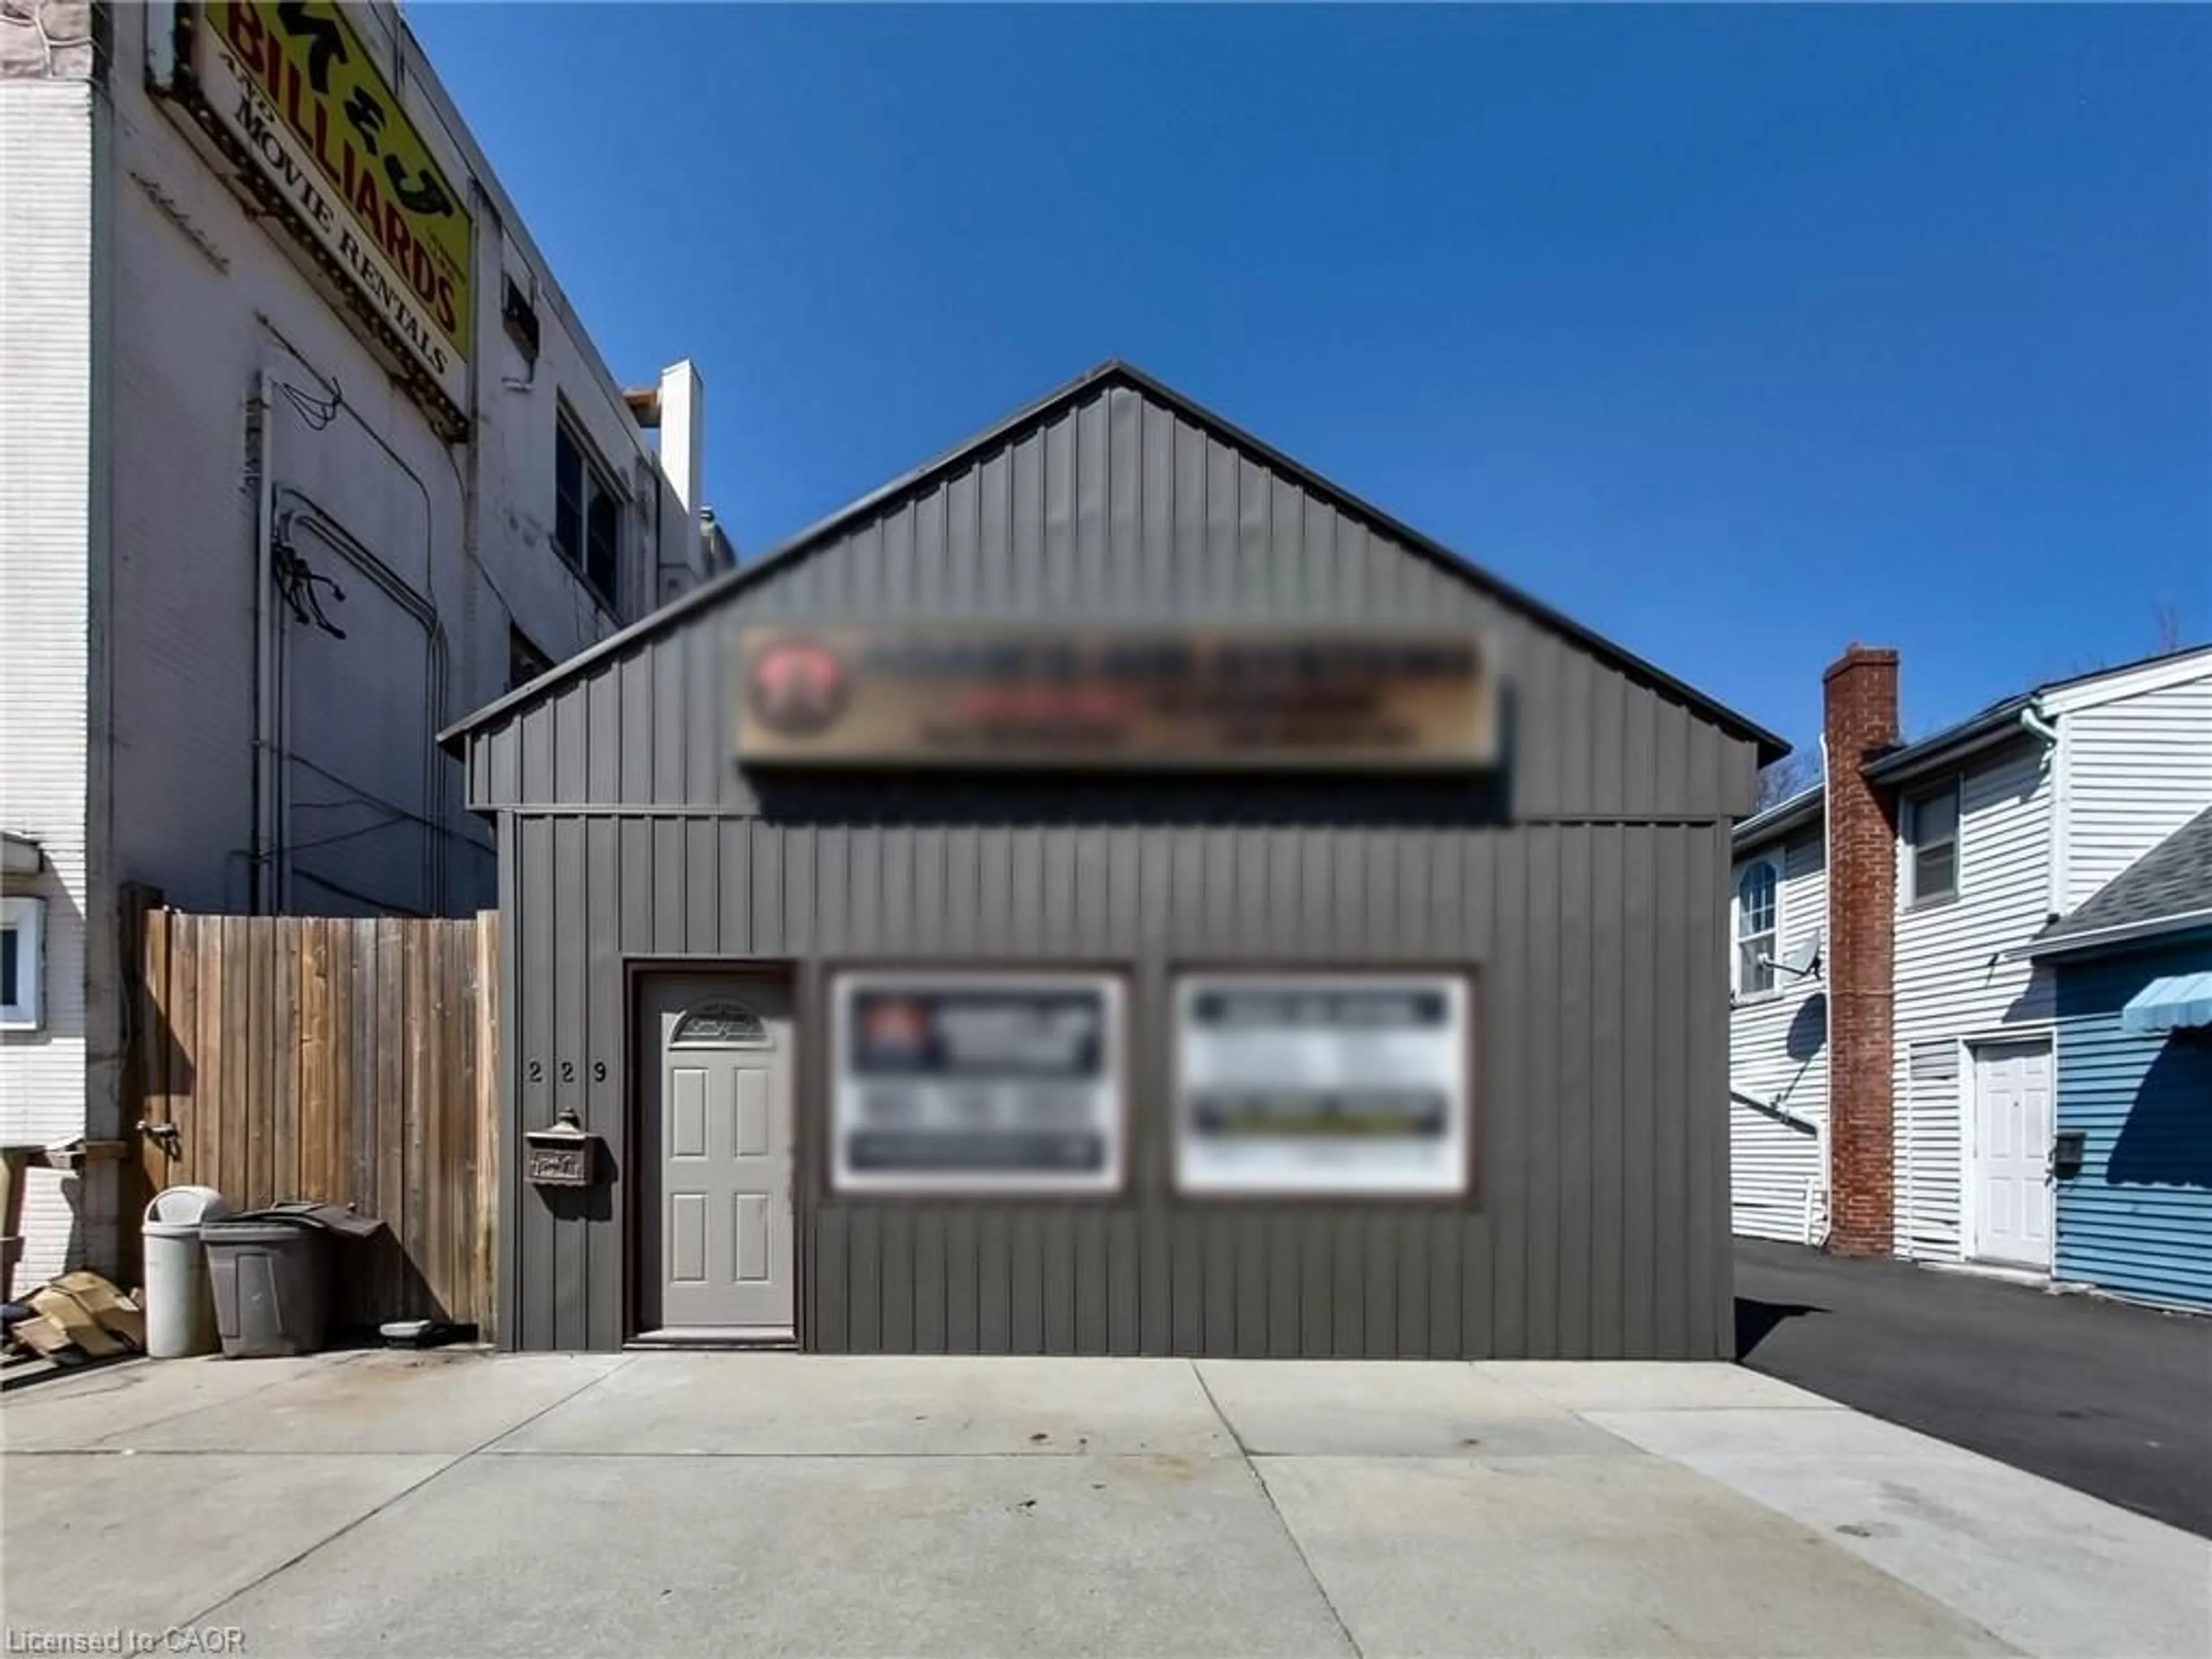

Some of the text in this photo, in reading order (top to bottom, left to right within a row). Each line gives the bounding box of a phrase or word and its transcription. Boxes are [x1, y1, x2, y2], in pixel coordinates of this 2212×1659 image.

[228, 0, 456, 334] BILLIARDS
[234, 94, 334, 233] MOVIE
[338, 225, 448, 375] RENTALS
[383, 153, 454, 219] J
[529, 1060, 607, 1083] 229
